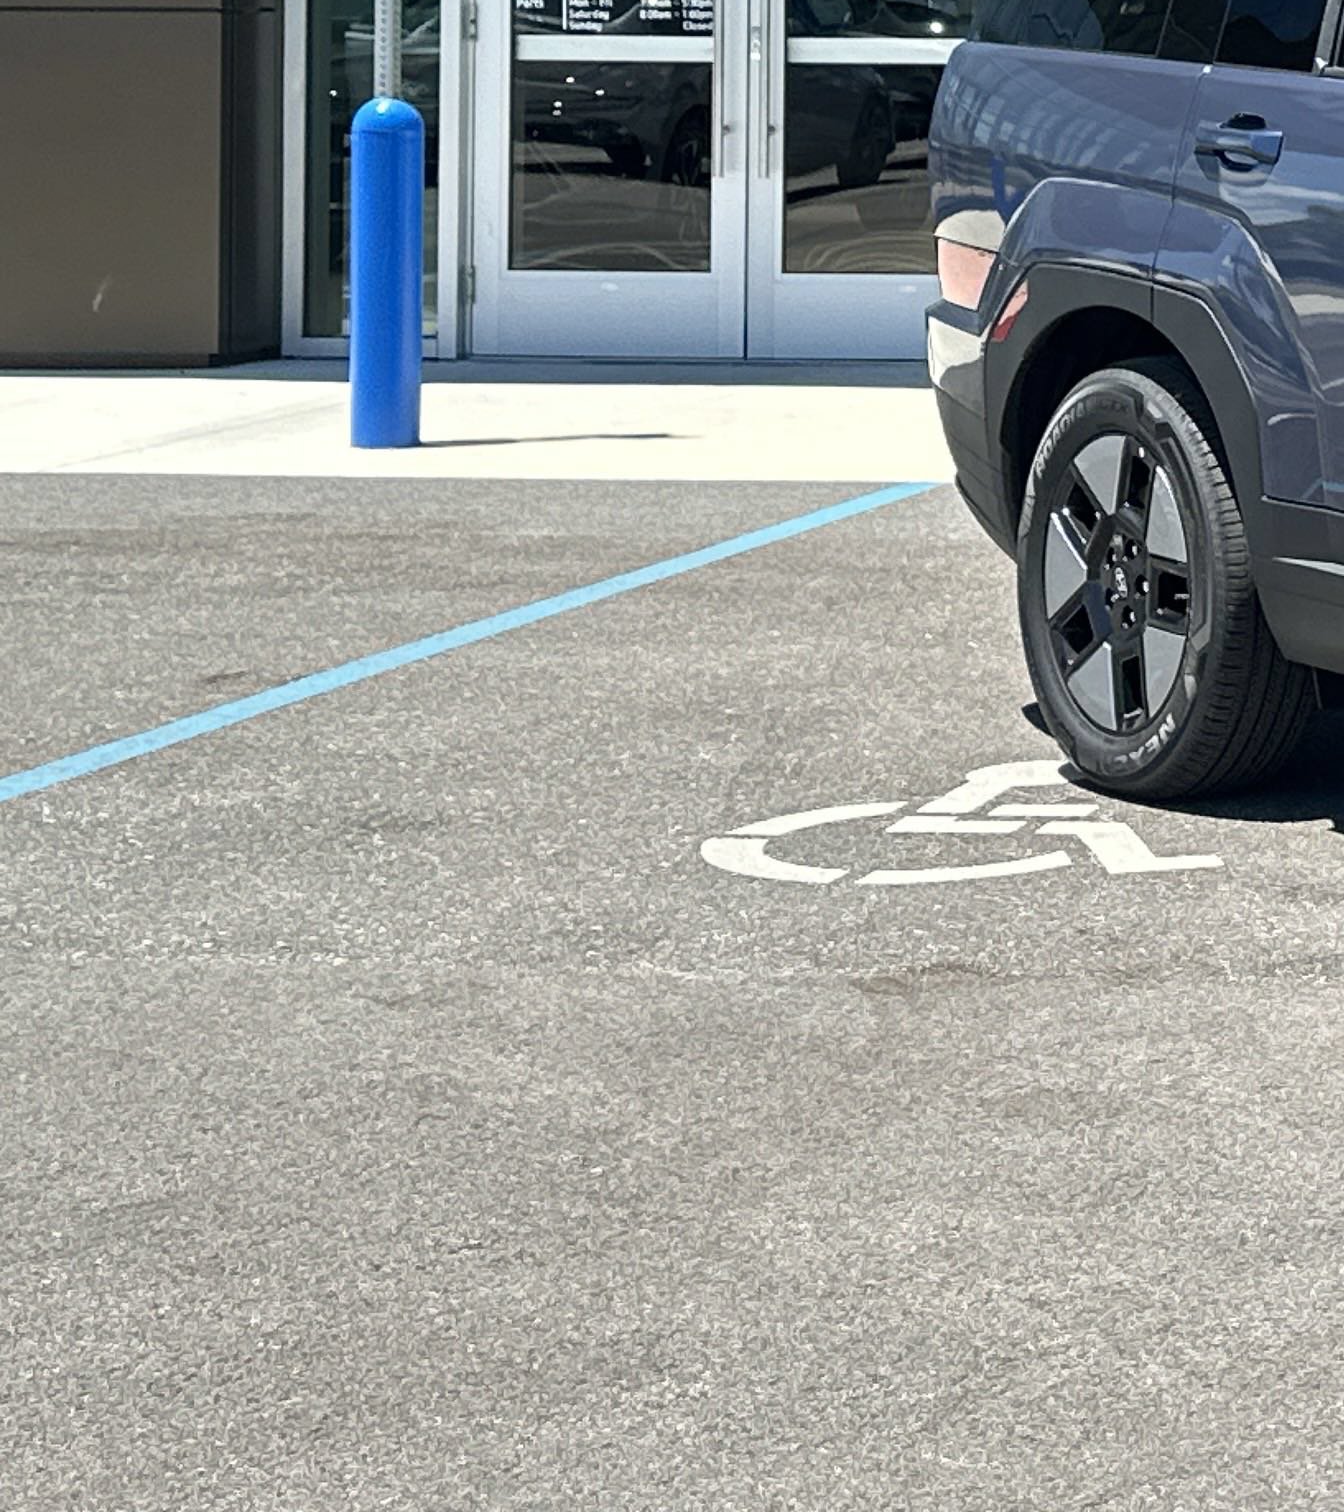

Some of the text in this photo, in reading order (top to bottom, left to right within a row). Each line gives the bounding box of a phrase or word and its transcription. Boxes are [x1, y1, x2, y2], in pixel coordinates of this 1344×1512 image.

[568, 8, 610, 21] Saturday
[568, 20, 713, 32] Sunday Closed
